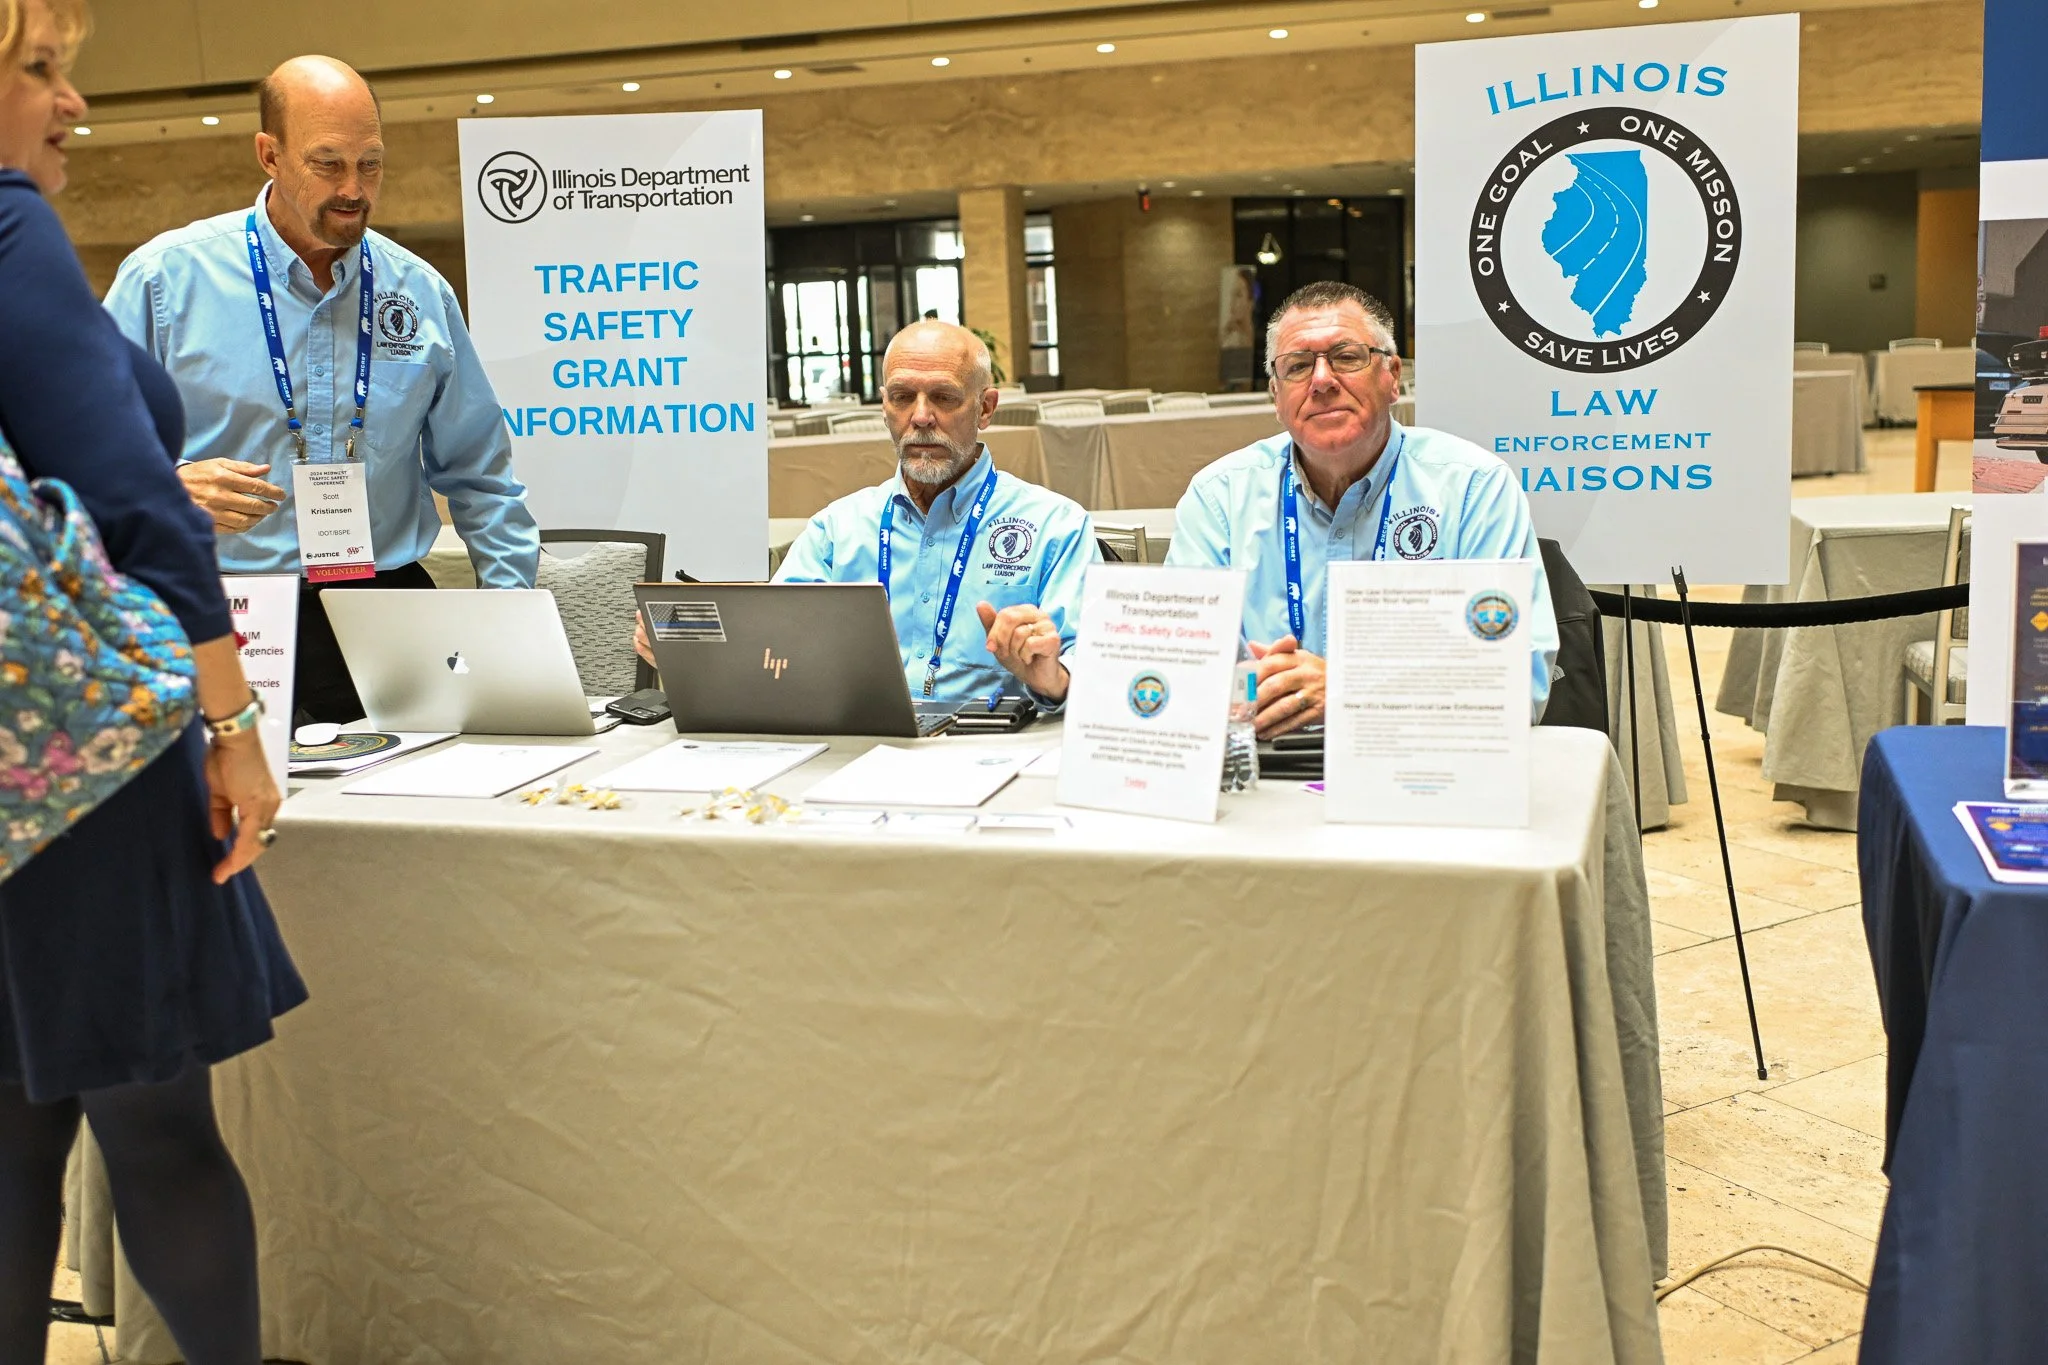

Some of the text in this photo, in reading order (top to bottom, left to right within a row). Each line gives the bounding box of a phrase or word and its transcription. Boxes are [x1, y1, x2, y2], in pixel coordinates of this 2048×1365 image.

[1485, 62, 1728, 116] ILLINOIS
[552, 164, 750, 190] Illinois Department
[1620, 115, 1734, 263] ONE MISSON
[553, 187, 733, 212] of Transportation
[1476, 138, 1553, 276] ONE GOAL
[534, 260, 699, 294] TRAFFIC
[377, 291, 415, 307] ILLINOIS
[544, 308, 694, 342] SAFETY
[1523, 326, 1681, 367] SAVE LIVES
[552, 356, 688, 389] GRANT
[1551, 389, 1659, 417] LAW
[502, 402, 755, 437] NFORMATION
[1494, 432, 1712, 453] ENFORCEMENT
[1520, 464, 1713, 492] IAISONS
[993, 517, 1034, 529] ILLINOIS
[1393, 505, 1436, 521] ILLINOIS
[315, 566, 368, 576] VOLUNTEER
[1122, 604, 1199, 619] Transportation
[1142, 591, 1205, 604] Department
[244, 646, 284, 657] agencies
[763, 648, 788, 679] hp
